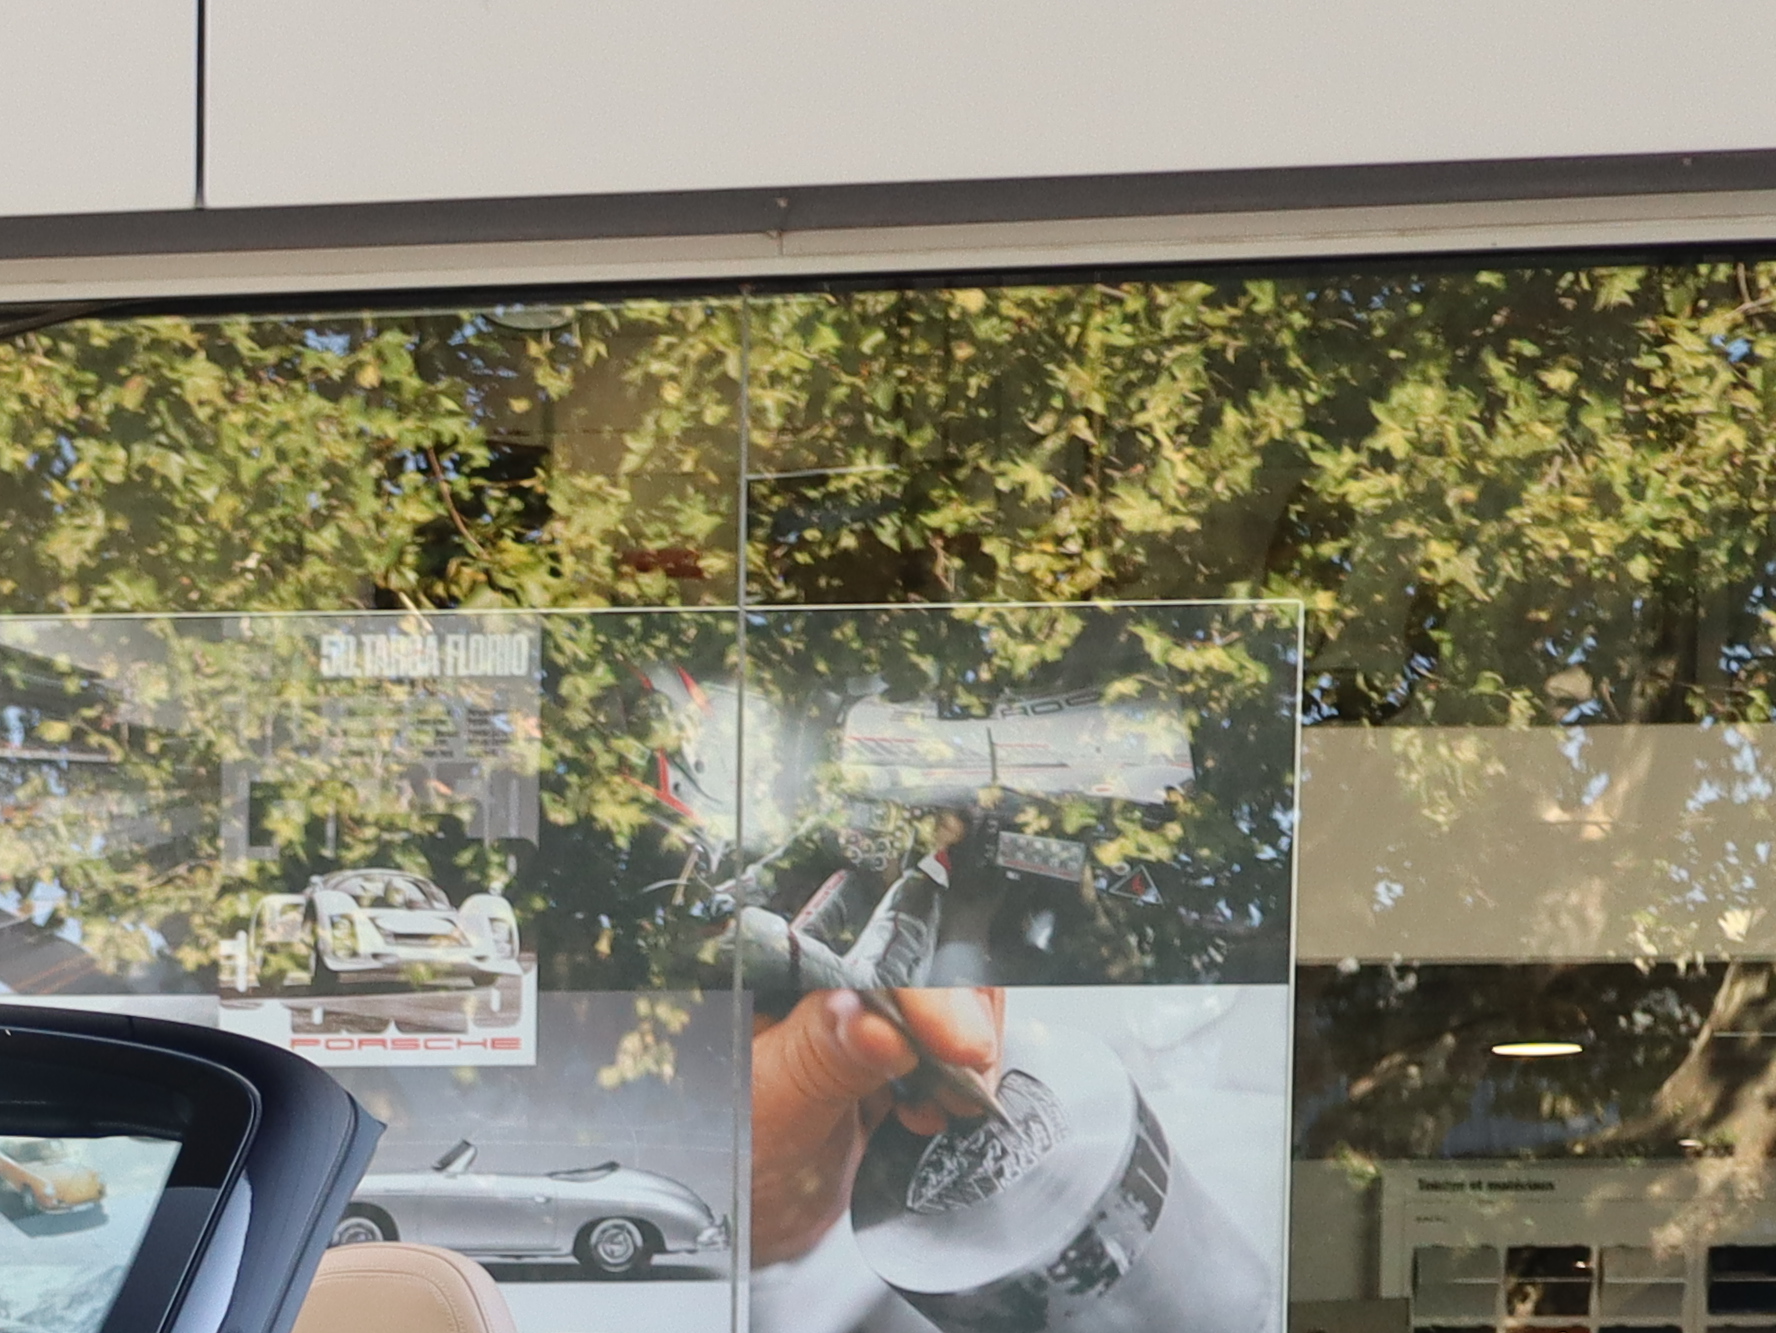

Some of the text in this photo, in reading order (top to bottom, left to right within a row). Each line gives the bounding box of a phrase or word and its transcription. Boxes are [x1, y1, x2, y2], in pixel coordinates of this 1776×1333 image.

[362, 634, 439, 676] TARGA
[447, 634, 529, 676] FLORIO
[290, 1037, 522, 1051] PORSCHE
